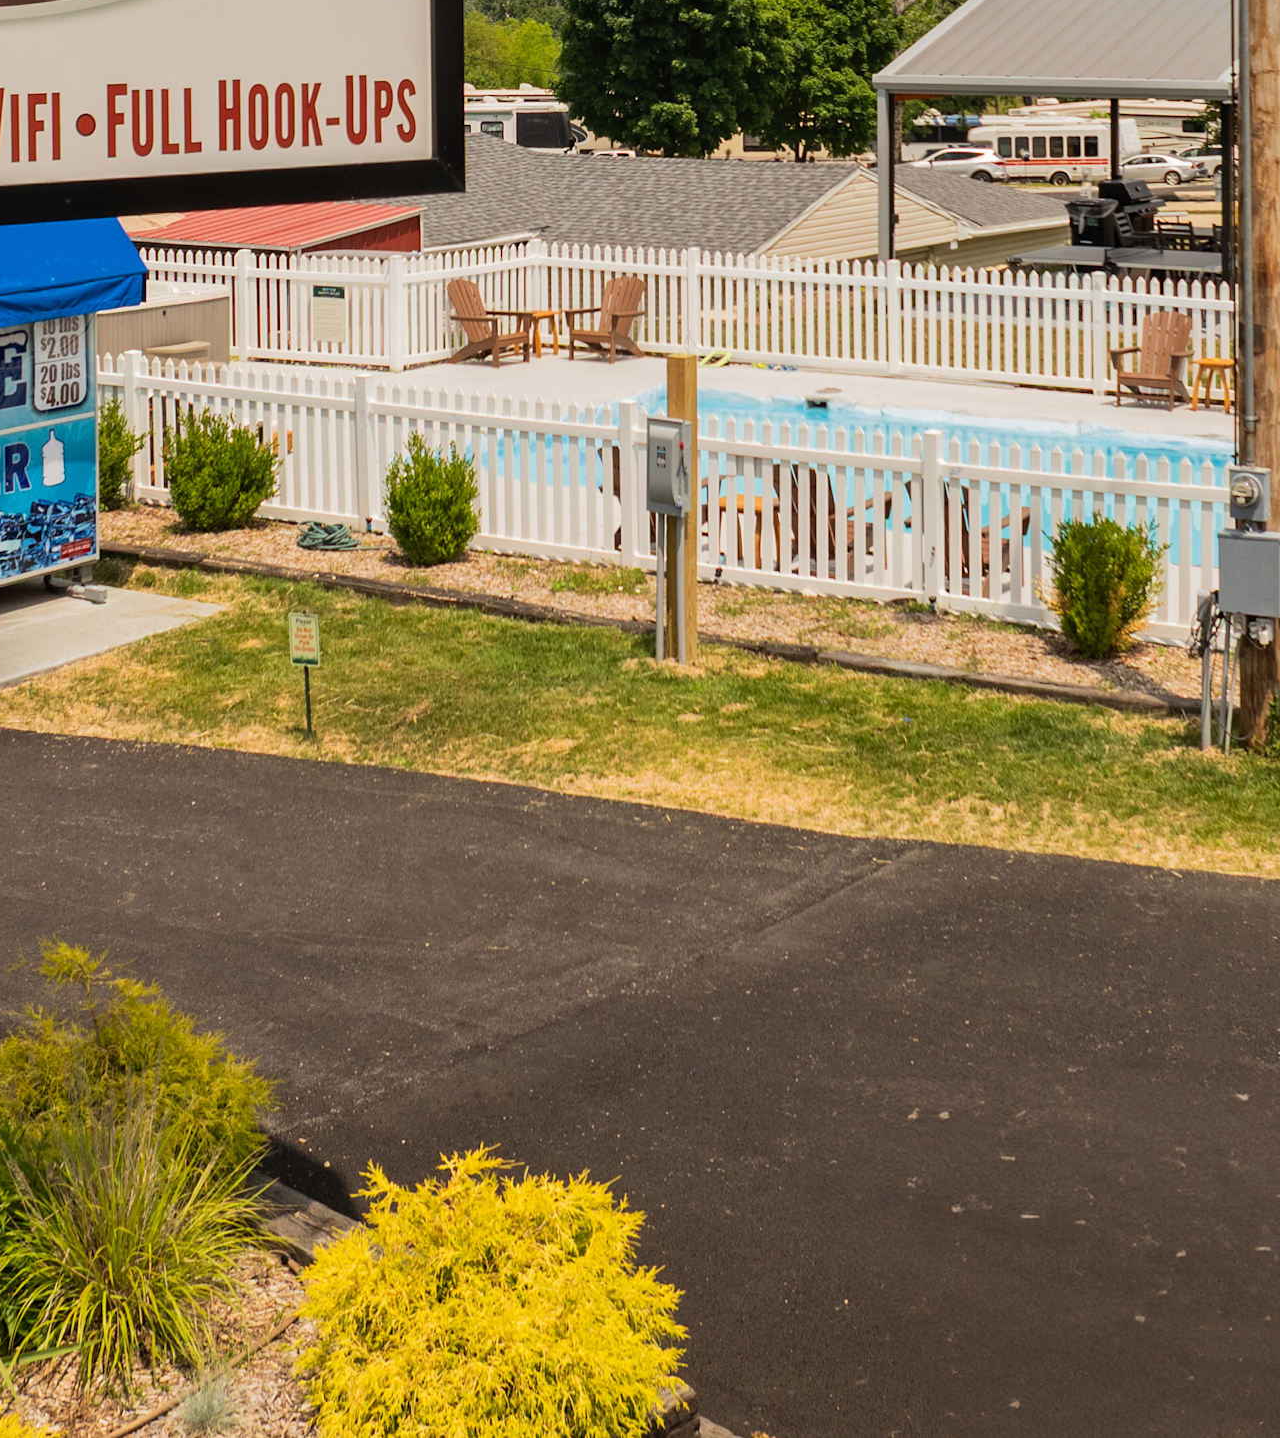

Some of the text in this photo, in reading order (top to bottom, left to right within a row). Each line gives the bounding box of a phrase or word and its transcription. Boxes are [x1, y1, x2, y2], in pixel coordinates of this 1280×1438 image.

[107, 83, 202, 158] FULL
[218, 75, 417, 152] HOOK-UPS
[40, 335, 80, 359] $2.00
[40, 362, 81, 385] 20 lbs
[40, 382, 80, 407] $4.00
